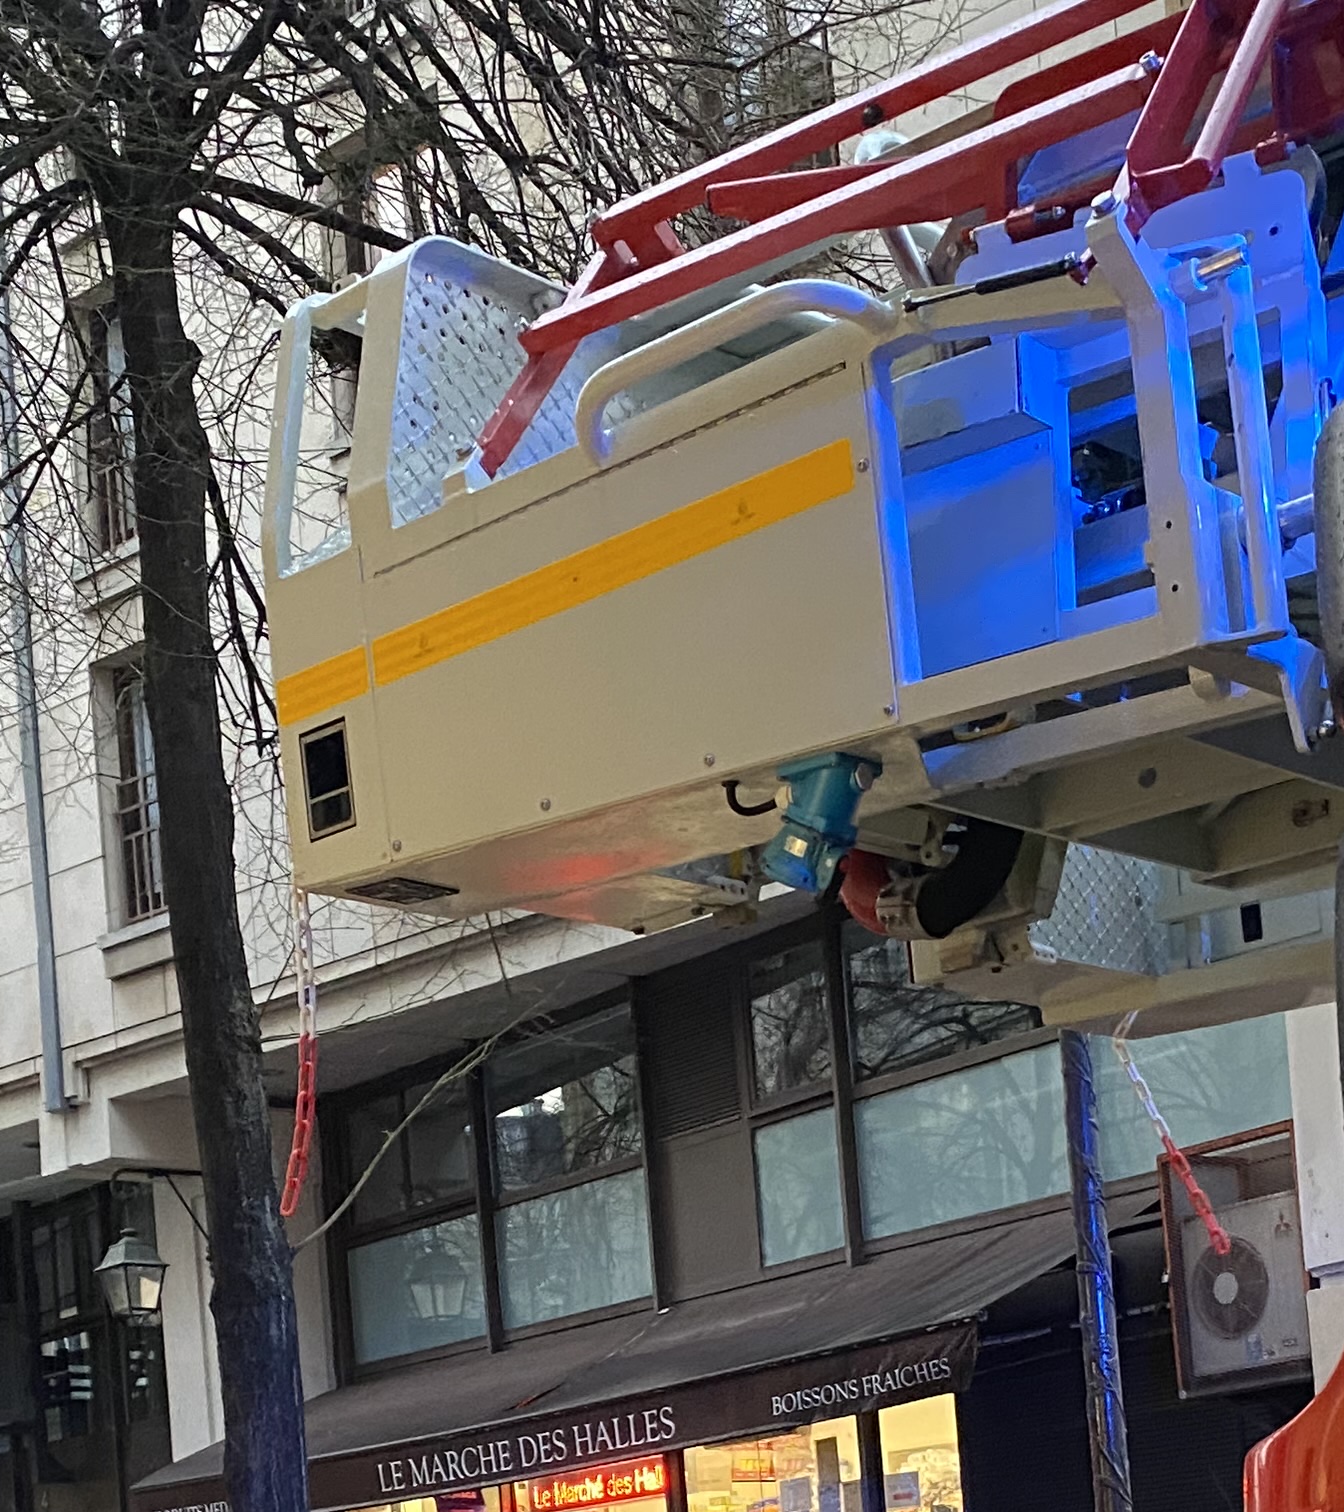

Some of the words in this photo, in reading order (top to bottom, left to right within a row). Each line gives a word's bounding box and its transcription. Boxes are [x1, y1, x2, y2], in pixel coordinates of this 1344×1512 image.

[771, 1379, 859, 1416] BOISSONS
[862, 1358, 952, 1397] FRAICHES
[377, 1459, 406, 1493] LE
[407, 1440, 513, 1487] MARCHE
[517, 1427, 568, 1467] DES
[571, 1406, 676, 1457] HALLES
[533, 1486, 553, 1509] Le
[607, 1473, 633, 1497] des
